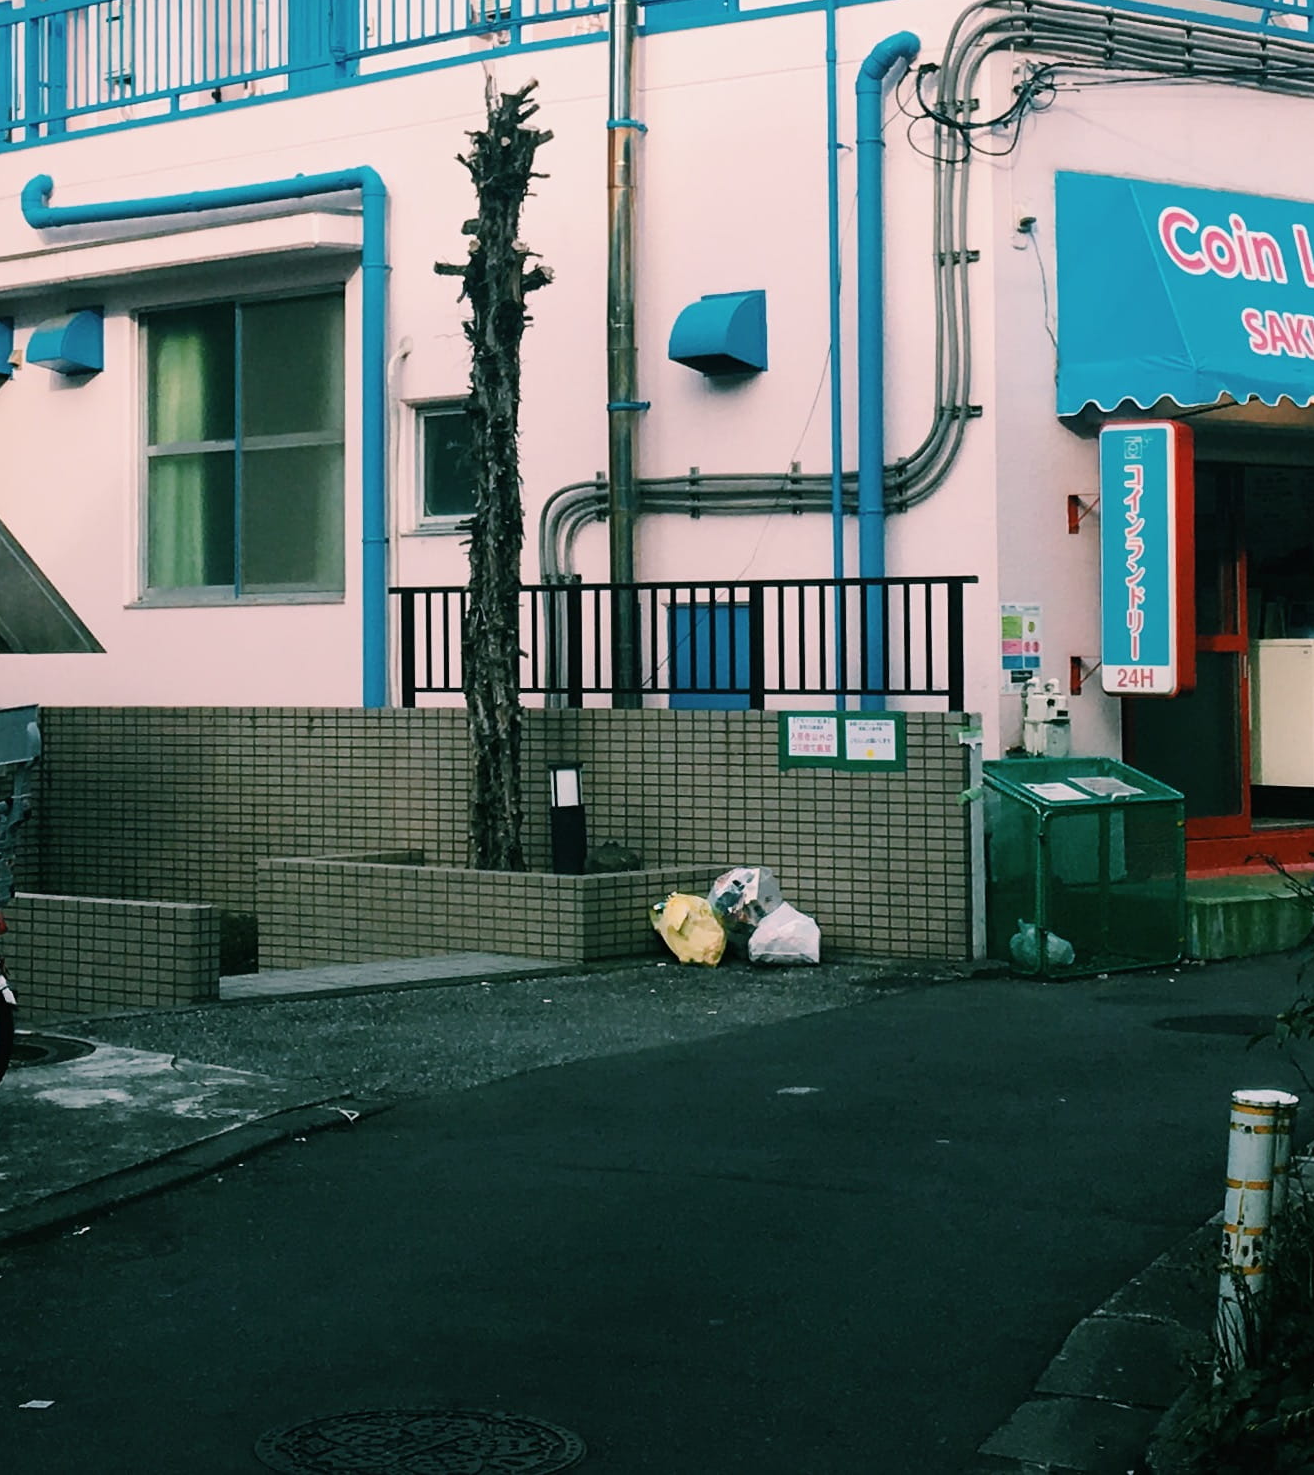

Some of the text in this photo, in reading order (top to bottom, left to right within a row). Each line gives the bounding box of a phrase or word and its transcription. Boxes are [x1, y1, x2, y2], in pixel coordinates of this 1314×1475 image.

[1158, 206, 1288, 284] Coin
[1123, 464, 1145, 662] コインランドリー
[1117, 668, 1154, 689] 24H
